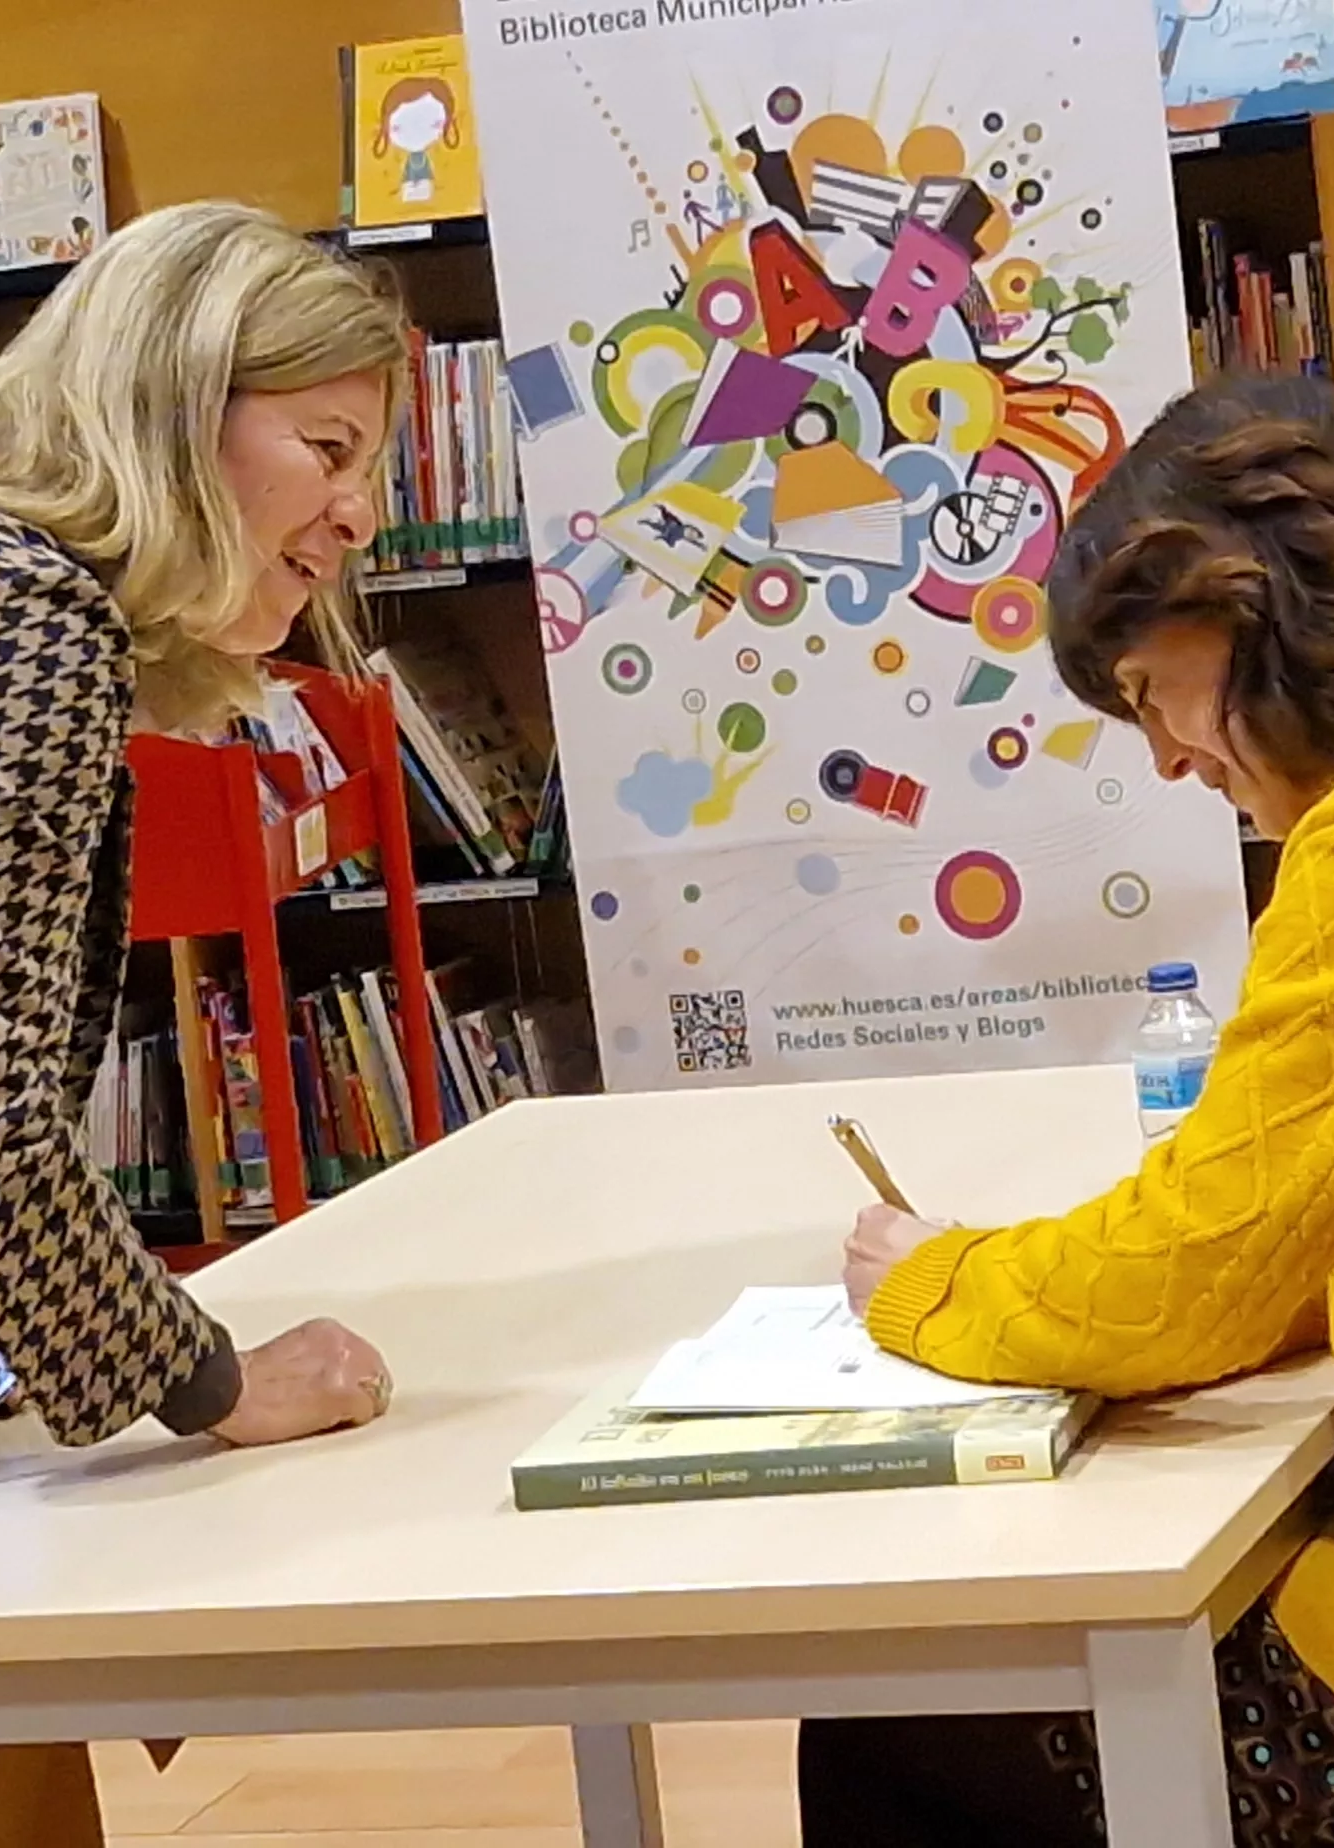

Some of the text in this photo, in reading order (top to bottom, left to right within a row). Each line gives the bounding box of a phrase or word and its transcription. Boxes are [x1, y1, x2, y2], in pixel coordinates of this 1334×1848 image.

[500, 0, 807, 45] Biblioteca Municipa
[776, 1015, 1046, 1052] Redes Sociales y Blogs
